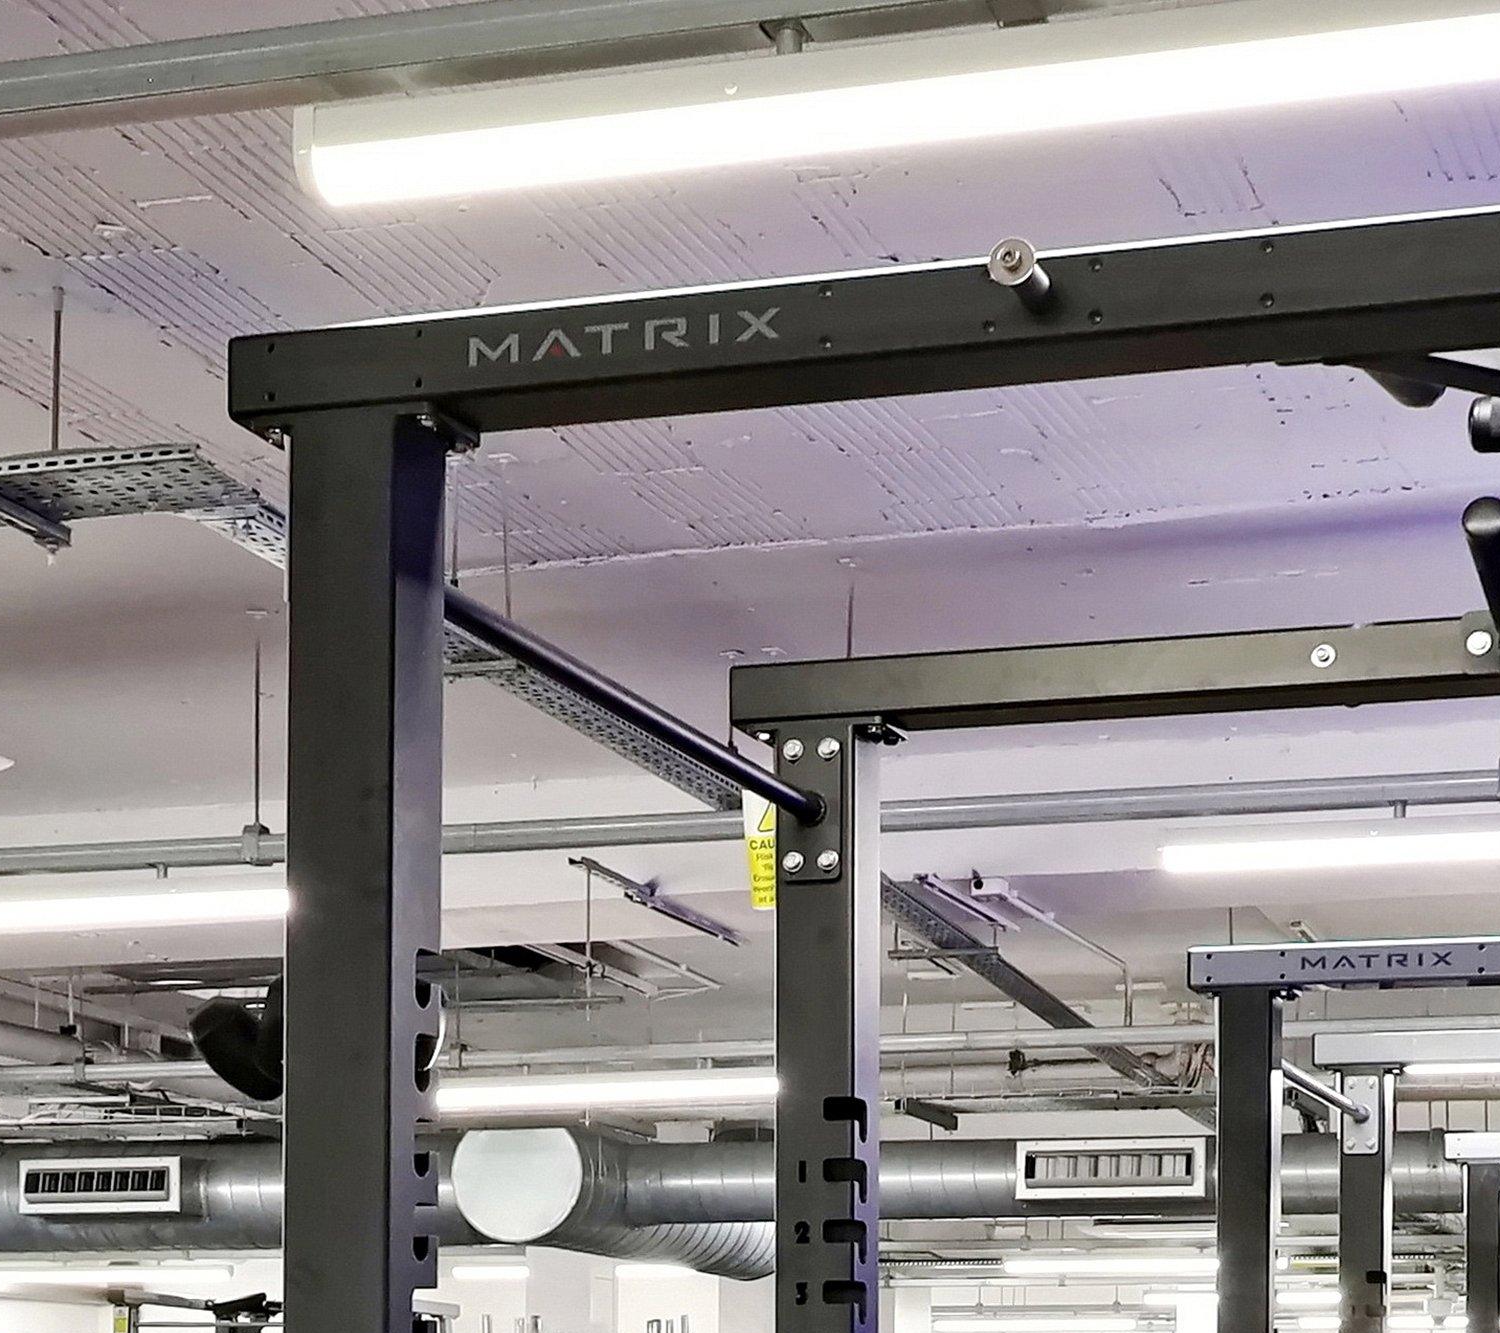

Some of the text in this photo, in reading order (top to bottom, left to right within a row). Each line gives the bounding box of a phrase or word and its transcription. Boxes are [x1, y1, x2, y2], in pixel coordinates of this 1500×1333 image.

[467, 308, 780, 367] MATRIX
[1300, 951, 1452, 970] MATRIX
[798, 1160, 807, 1183] 1
[794, 1220, 810, 1244] 2
[795, 1281, 808, 1305] 3
